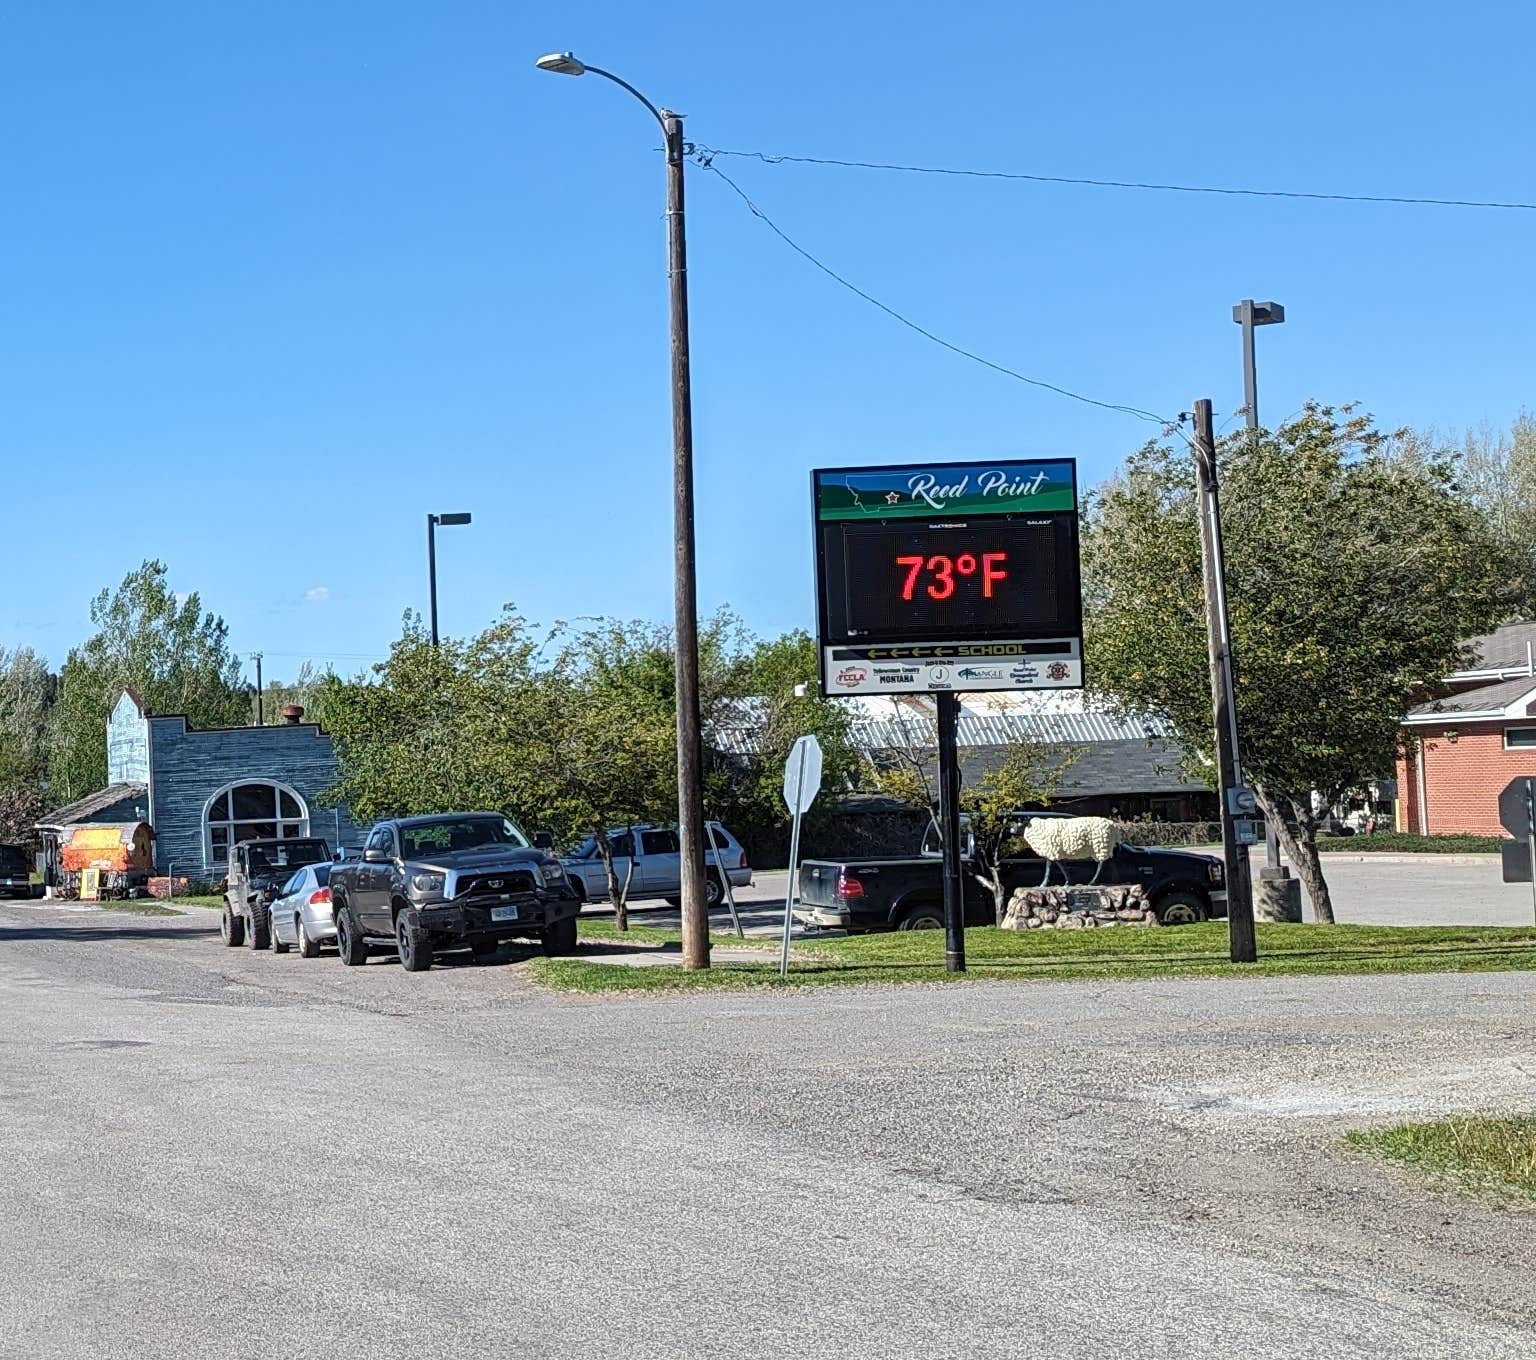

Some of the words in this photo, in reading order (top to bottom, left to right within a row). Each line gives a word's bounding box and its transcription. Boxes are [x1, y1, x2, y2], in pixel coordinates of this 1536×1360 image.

[907, 473, 968, 510] Reed
[977, 470, 1050, 497] Point
[896, 552, 1008, 600] 73°F
[958, 644, 1027, 656] SCHOOL
[880, 675, 914, 684] MONTANA
[935, 668, 943, 679] J
